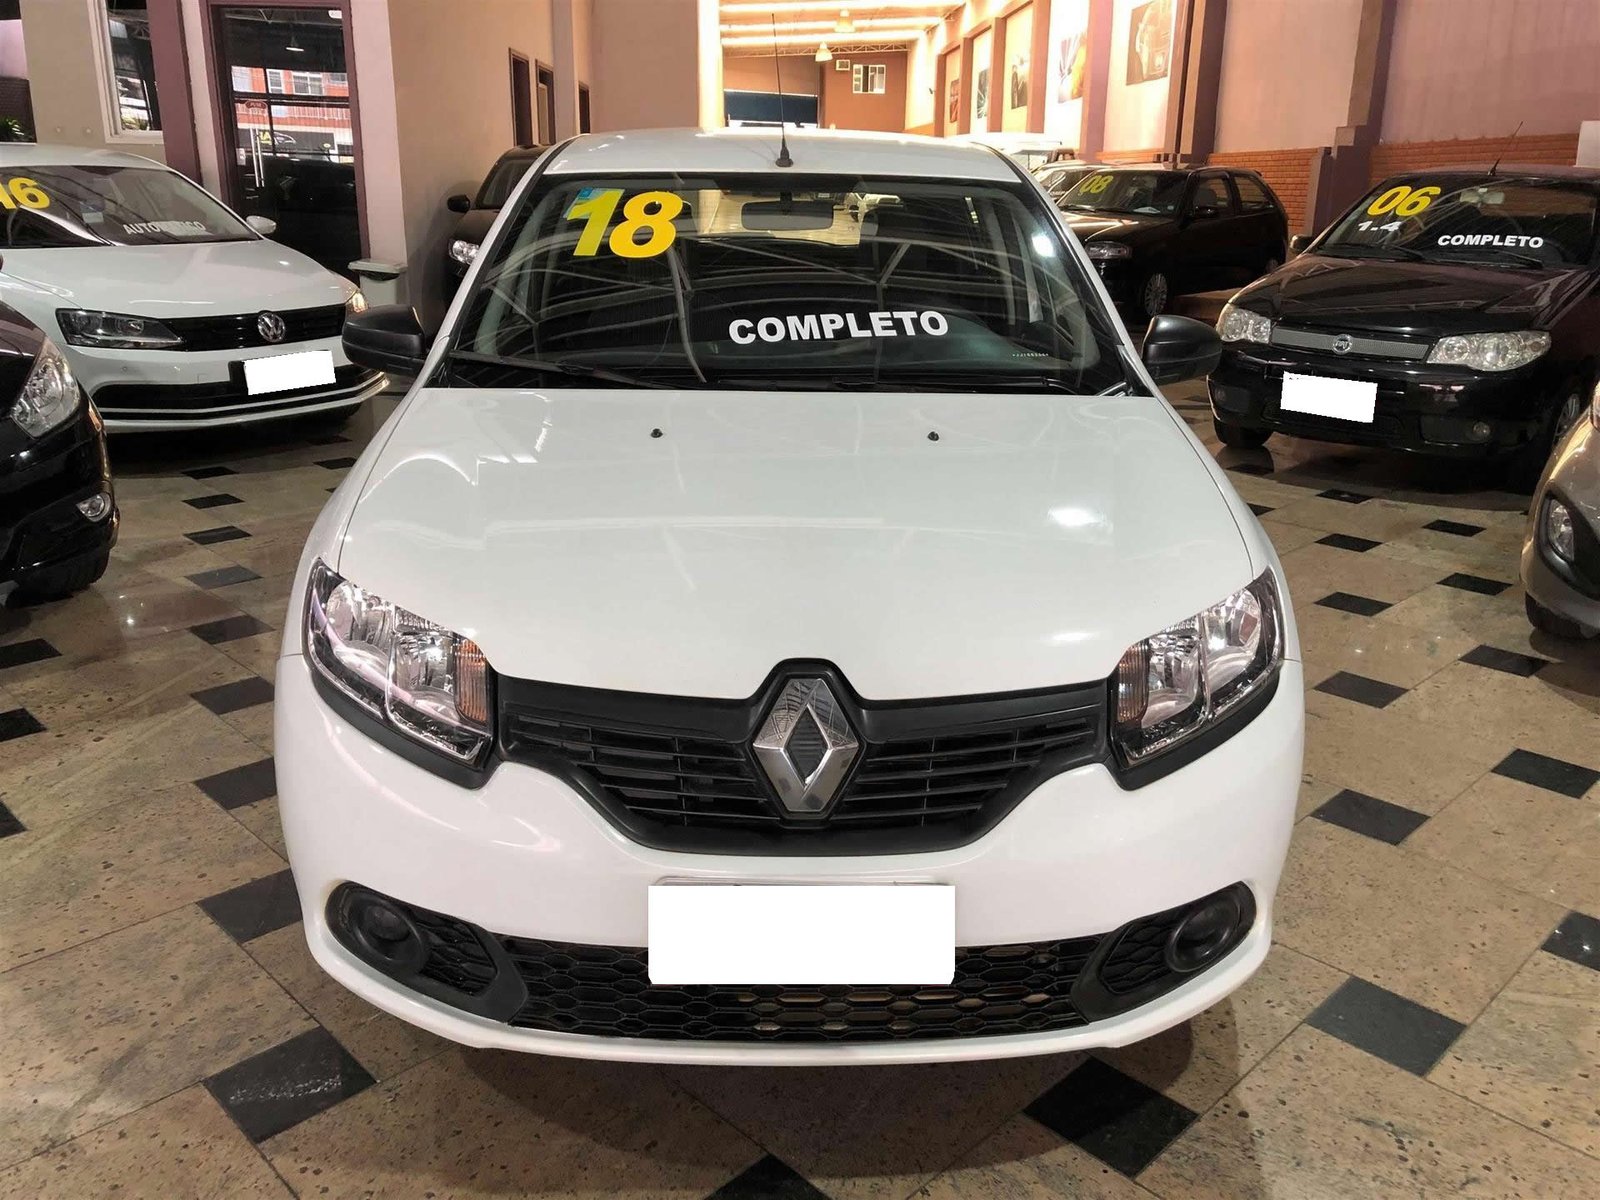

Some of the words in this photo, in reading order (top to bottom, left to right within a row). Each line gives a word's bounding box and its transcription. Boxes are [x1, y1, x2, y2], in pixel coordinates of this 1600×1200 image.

[1367, 185, 1442, 217] 06
[566, 188, 684, 259] 18
[1358, 220, 1402, 232] 1.4
[1437, 234, 1544, 249] COMPLETO
[728, 310, 949, 345] COMPLETO
